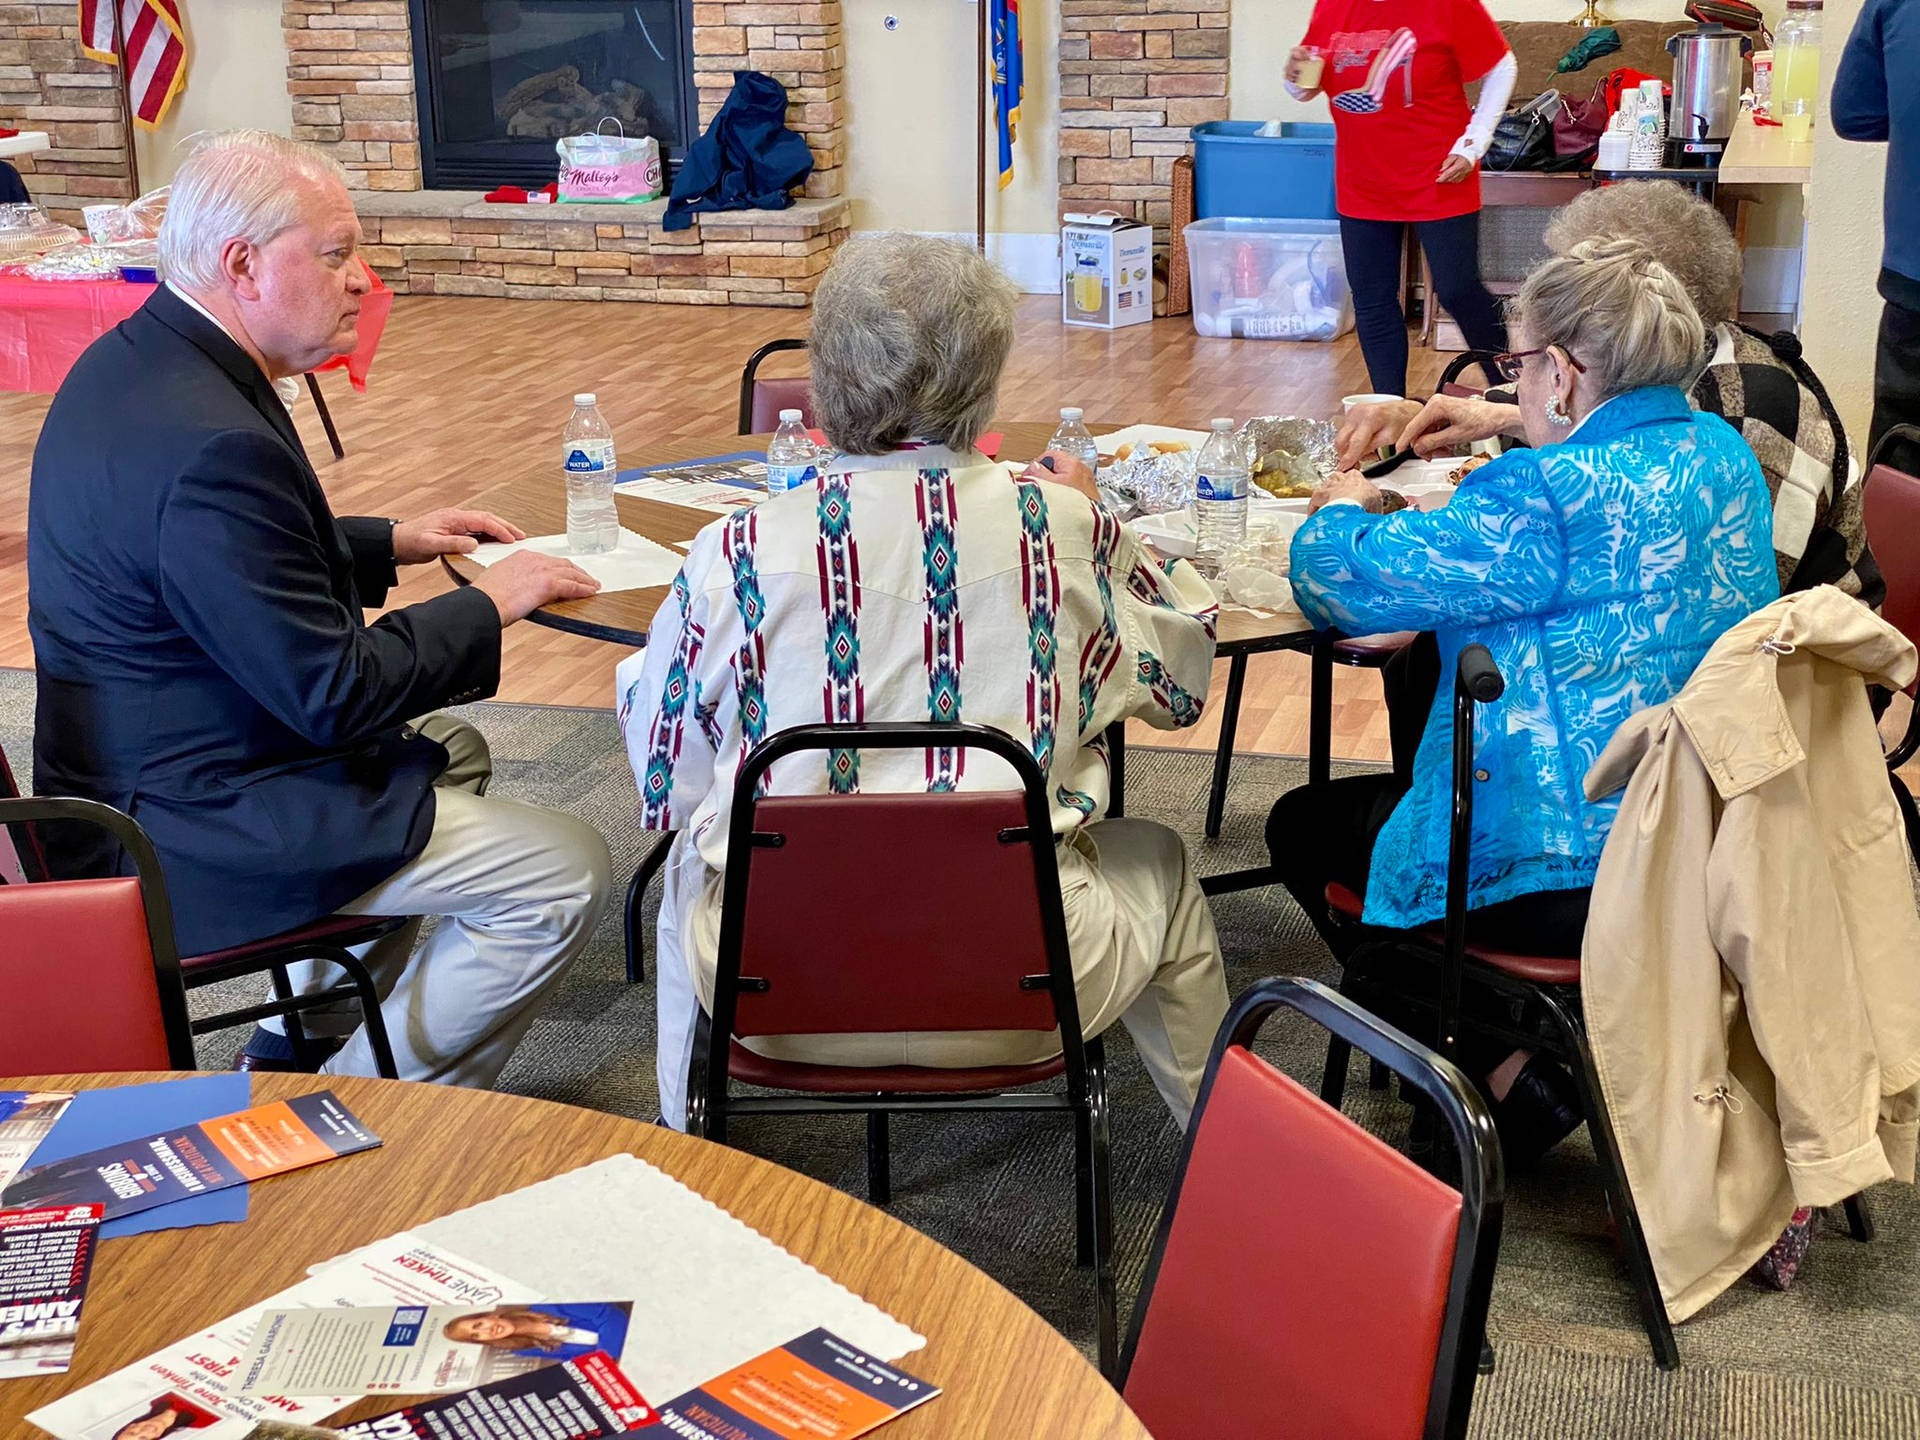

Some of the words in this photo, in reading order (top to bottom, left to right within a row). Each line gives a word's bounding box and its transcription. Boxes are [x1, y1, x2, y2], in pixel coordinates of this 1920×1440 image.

[570, 168, 619, 187] Malley's
[146, 1138, 202, 1187] BUSINESSMAN,
[94, 1162, 147, 1198] GIBBONS
[2, 1223, 47, 1232] PATRIOT
[50, 1218, 100, 1228] VETERAN
[4, 1234, 38, 1243] GROWTH
[40, 1230, 81, 1238] ECONOMIC
[38, 1246, 59, 1254] MOST
[46, 1250, 76, 1259] ENERGY
[16, 1261, 46, 1270] HEALTH
[48, 1258, 75, 1266] LOWER
[36, 1265, 73, 1275] PARENTAL
[391, 1254, 453, 1285] TIMKEN
[15, 1282, 51, 1291] AMERICA
[51, 1280, 70, 1288] OUR
[446, 1278, 493, 1302] JANE
[241, 1355, 267, 1390] THERESA
[258, 1314, 286, 1353] GAVARONE
[182, 1351, 233, 1378] FIRST
[147, 1362, 195, 1392] Timken
[192, 1386, 227, 1408] Jane
